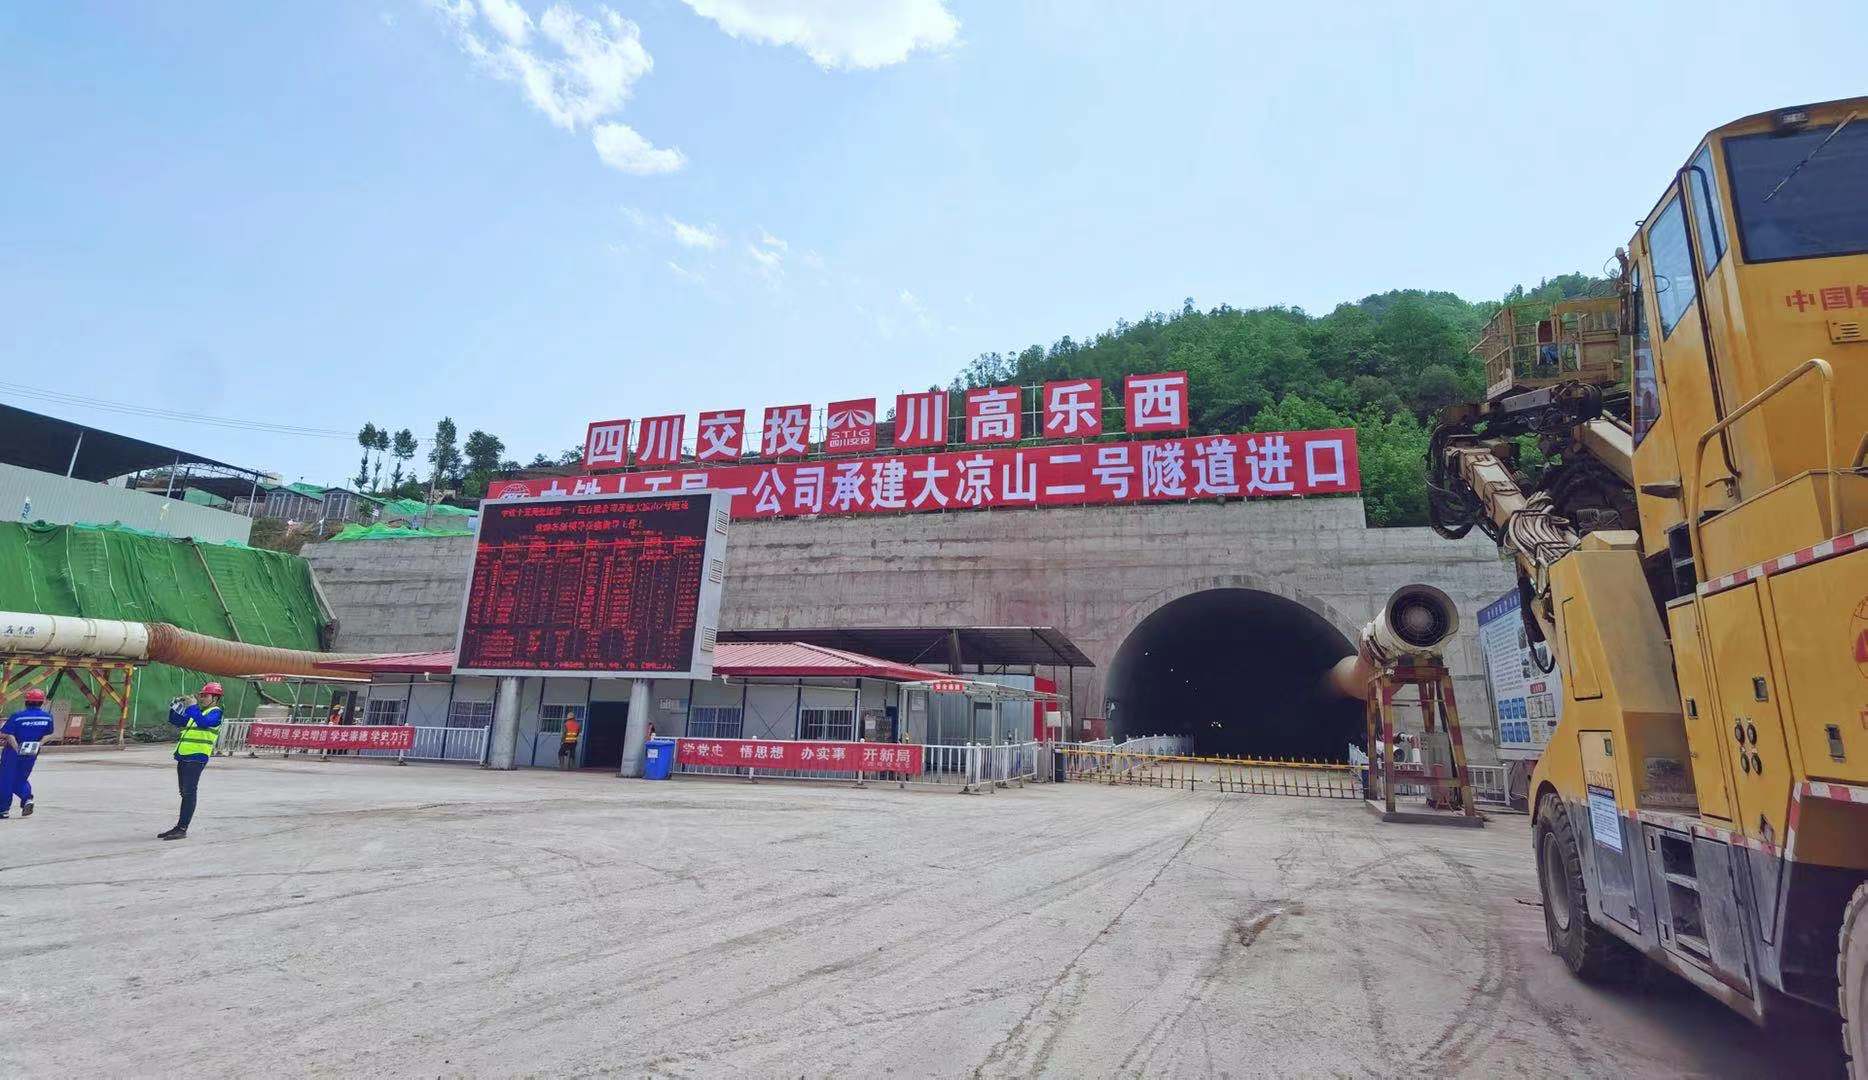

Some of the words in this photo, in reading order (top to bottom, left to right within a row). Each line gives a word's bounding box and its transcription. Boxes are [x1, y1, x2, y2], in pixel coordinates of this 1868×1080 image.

[587, 405, 808, 465] 四川交投
[899, 377, 1184, 442] 川高乐西
[831, 429, 870, 439] STIG
[371, 730, 409, 742] 学史力行
[682, 743, 724, 758] 学党史
[740, 745, 784, 760] 悟思想
[801, 746, 846, 761] 办实事
[863, 748, 910, 763] 开新局
